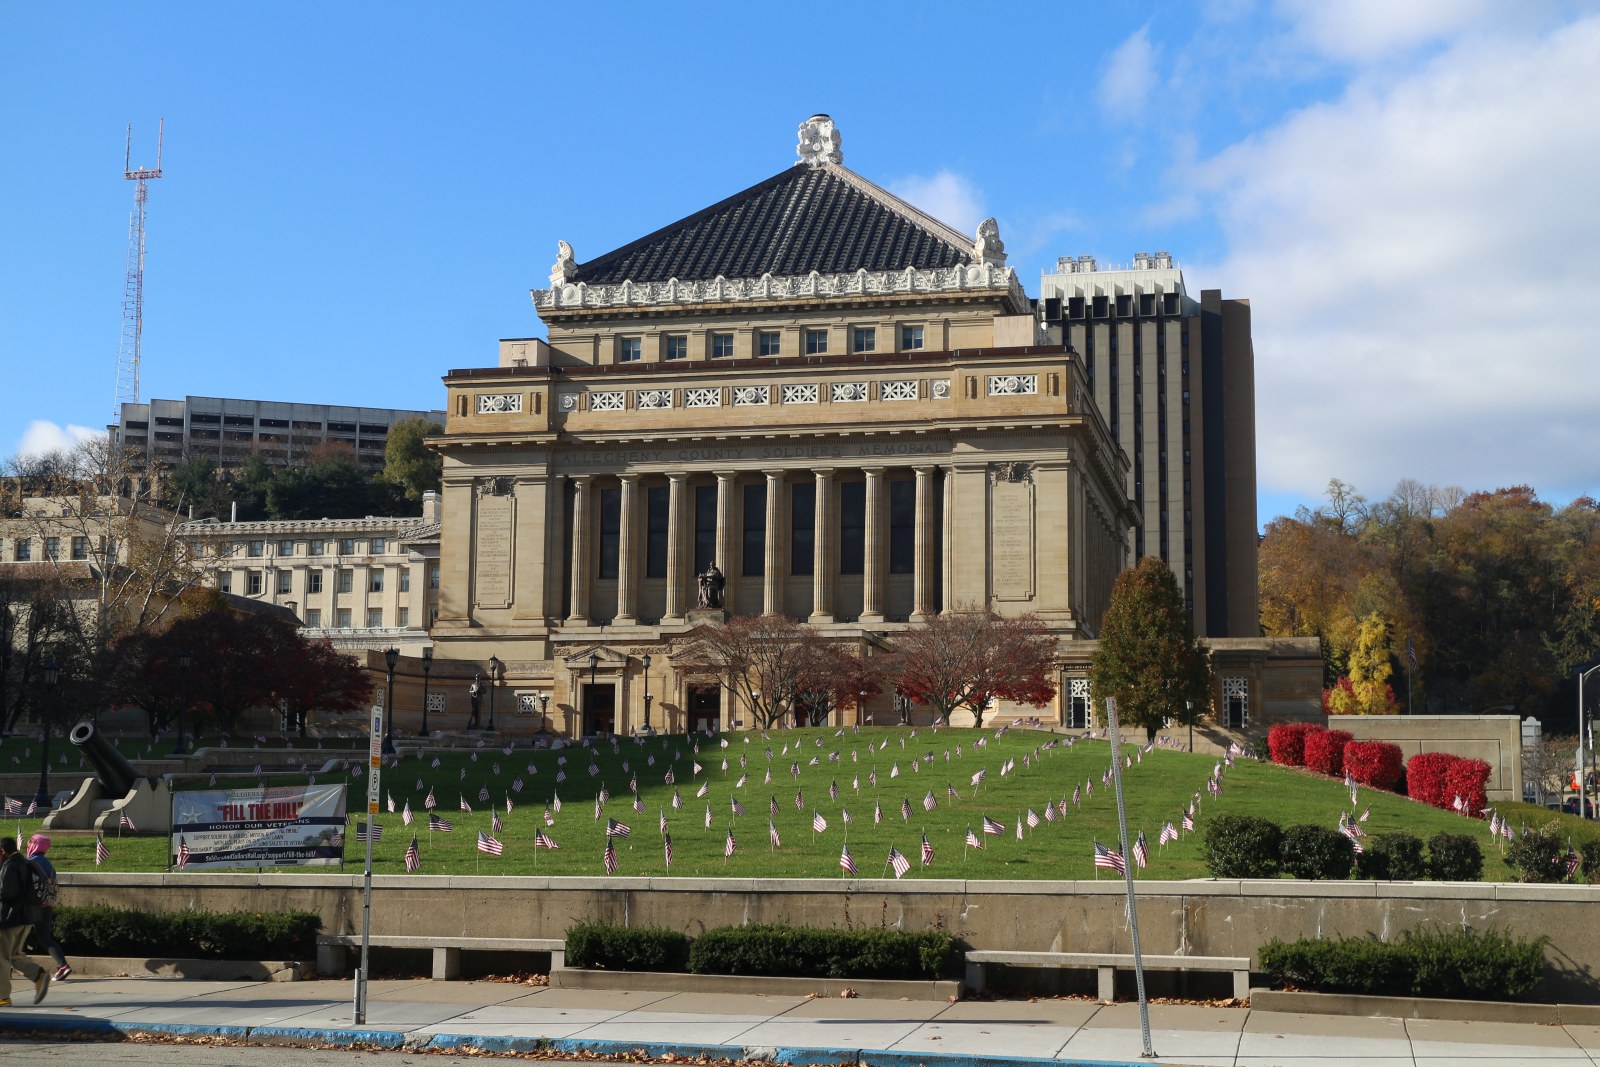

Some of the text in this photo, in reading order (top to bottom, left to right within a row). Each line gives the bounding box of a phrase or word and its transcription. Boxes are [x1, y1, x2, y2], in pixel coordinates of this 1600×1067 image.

[560, 451, 662, 464] ALLEGHENY
[678, 448, 745, 460] COUNTY
[248, 803, 271, 820] THE
